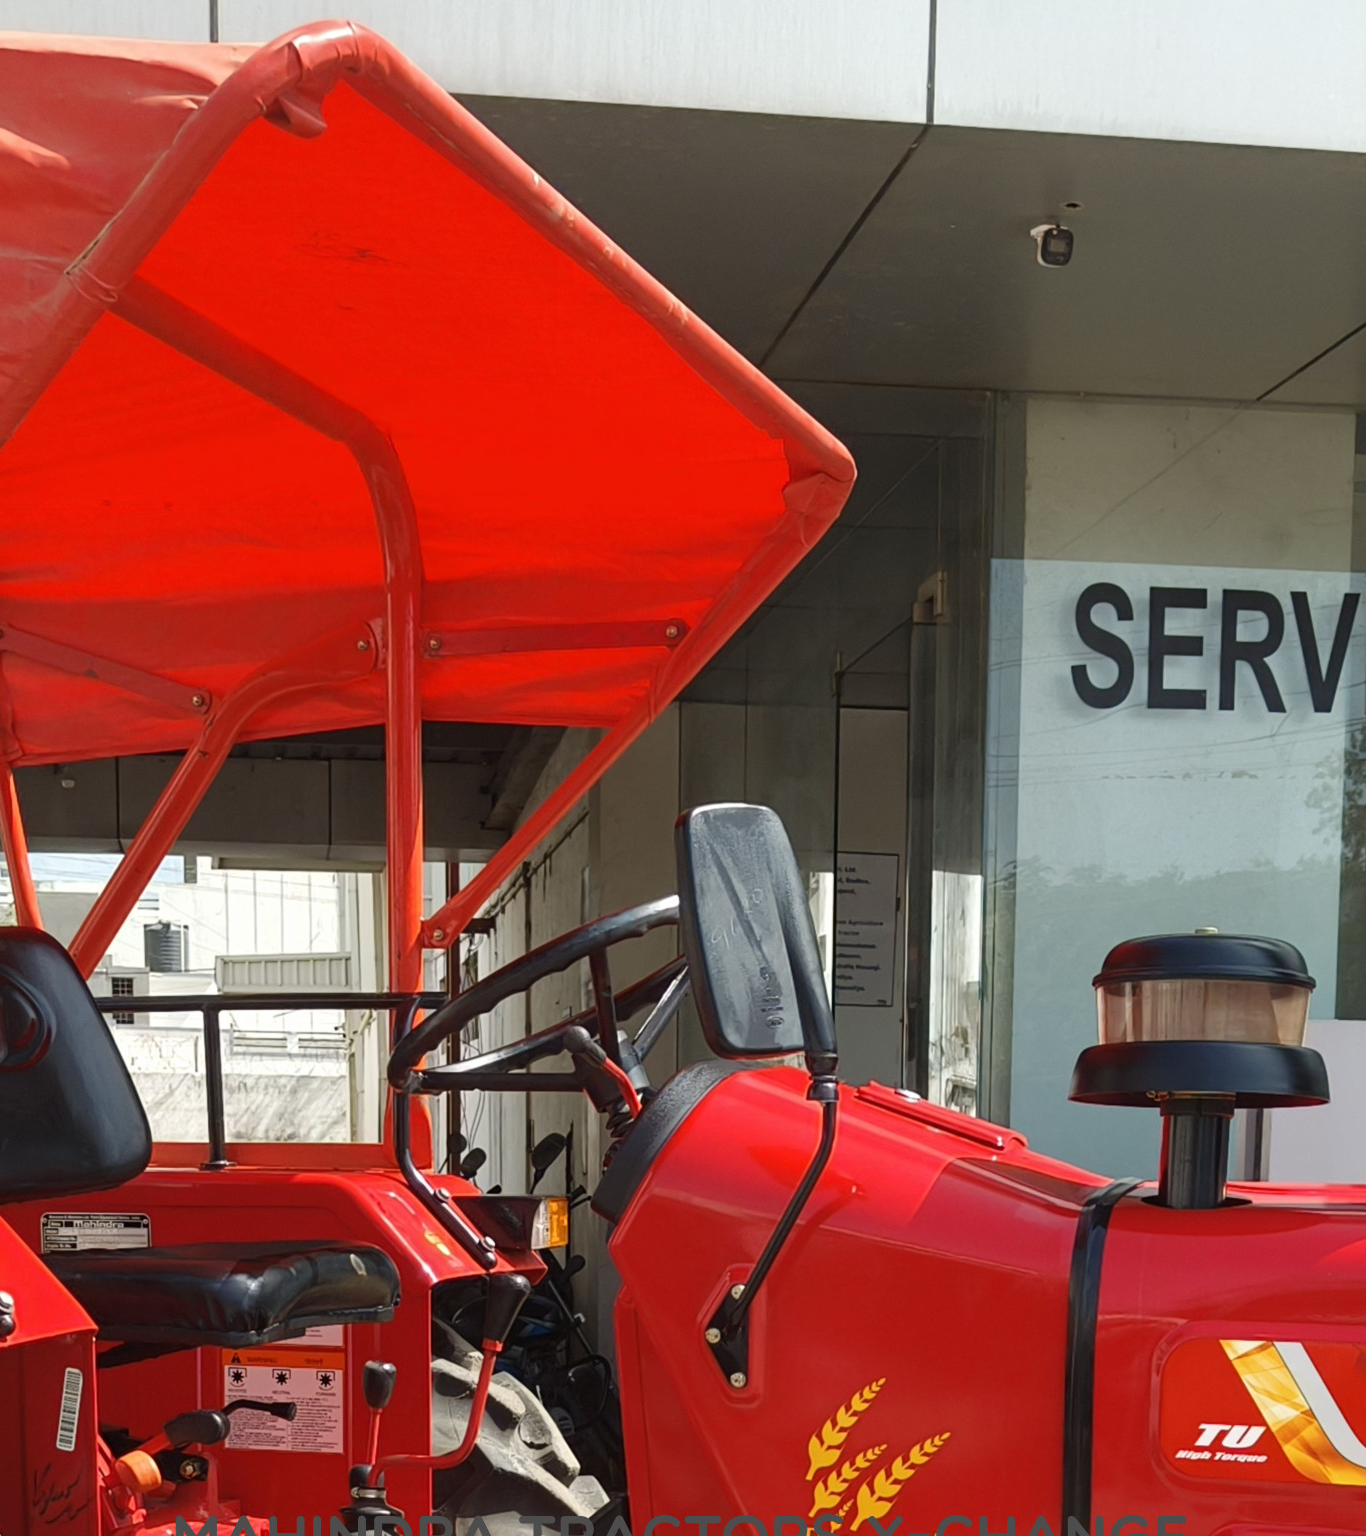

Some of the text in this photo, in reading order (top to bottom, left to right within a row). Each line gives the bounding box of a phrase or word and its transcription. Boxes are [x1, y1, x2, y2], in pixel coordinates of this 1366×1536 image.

[1194, 1423, 1267, 1449] TU
[1175, 1449, 1268, 1463] High Torque
